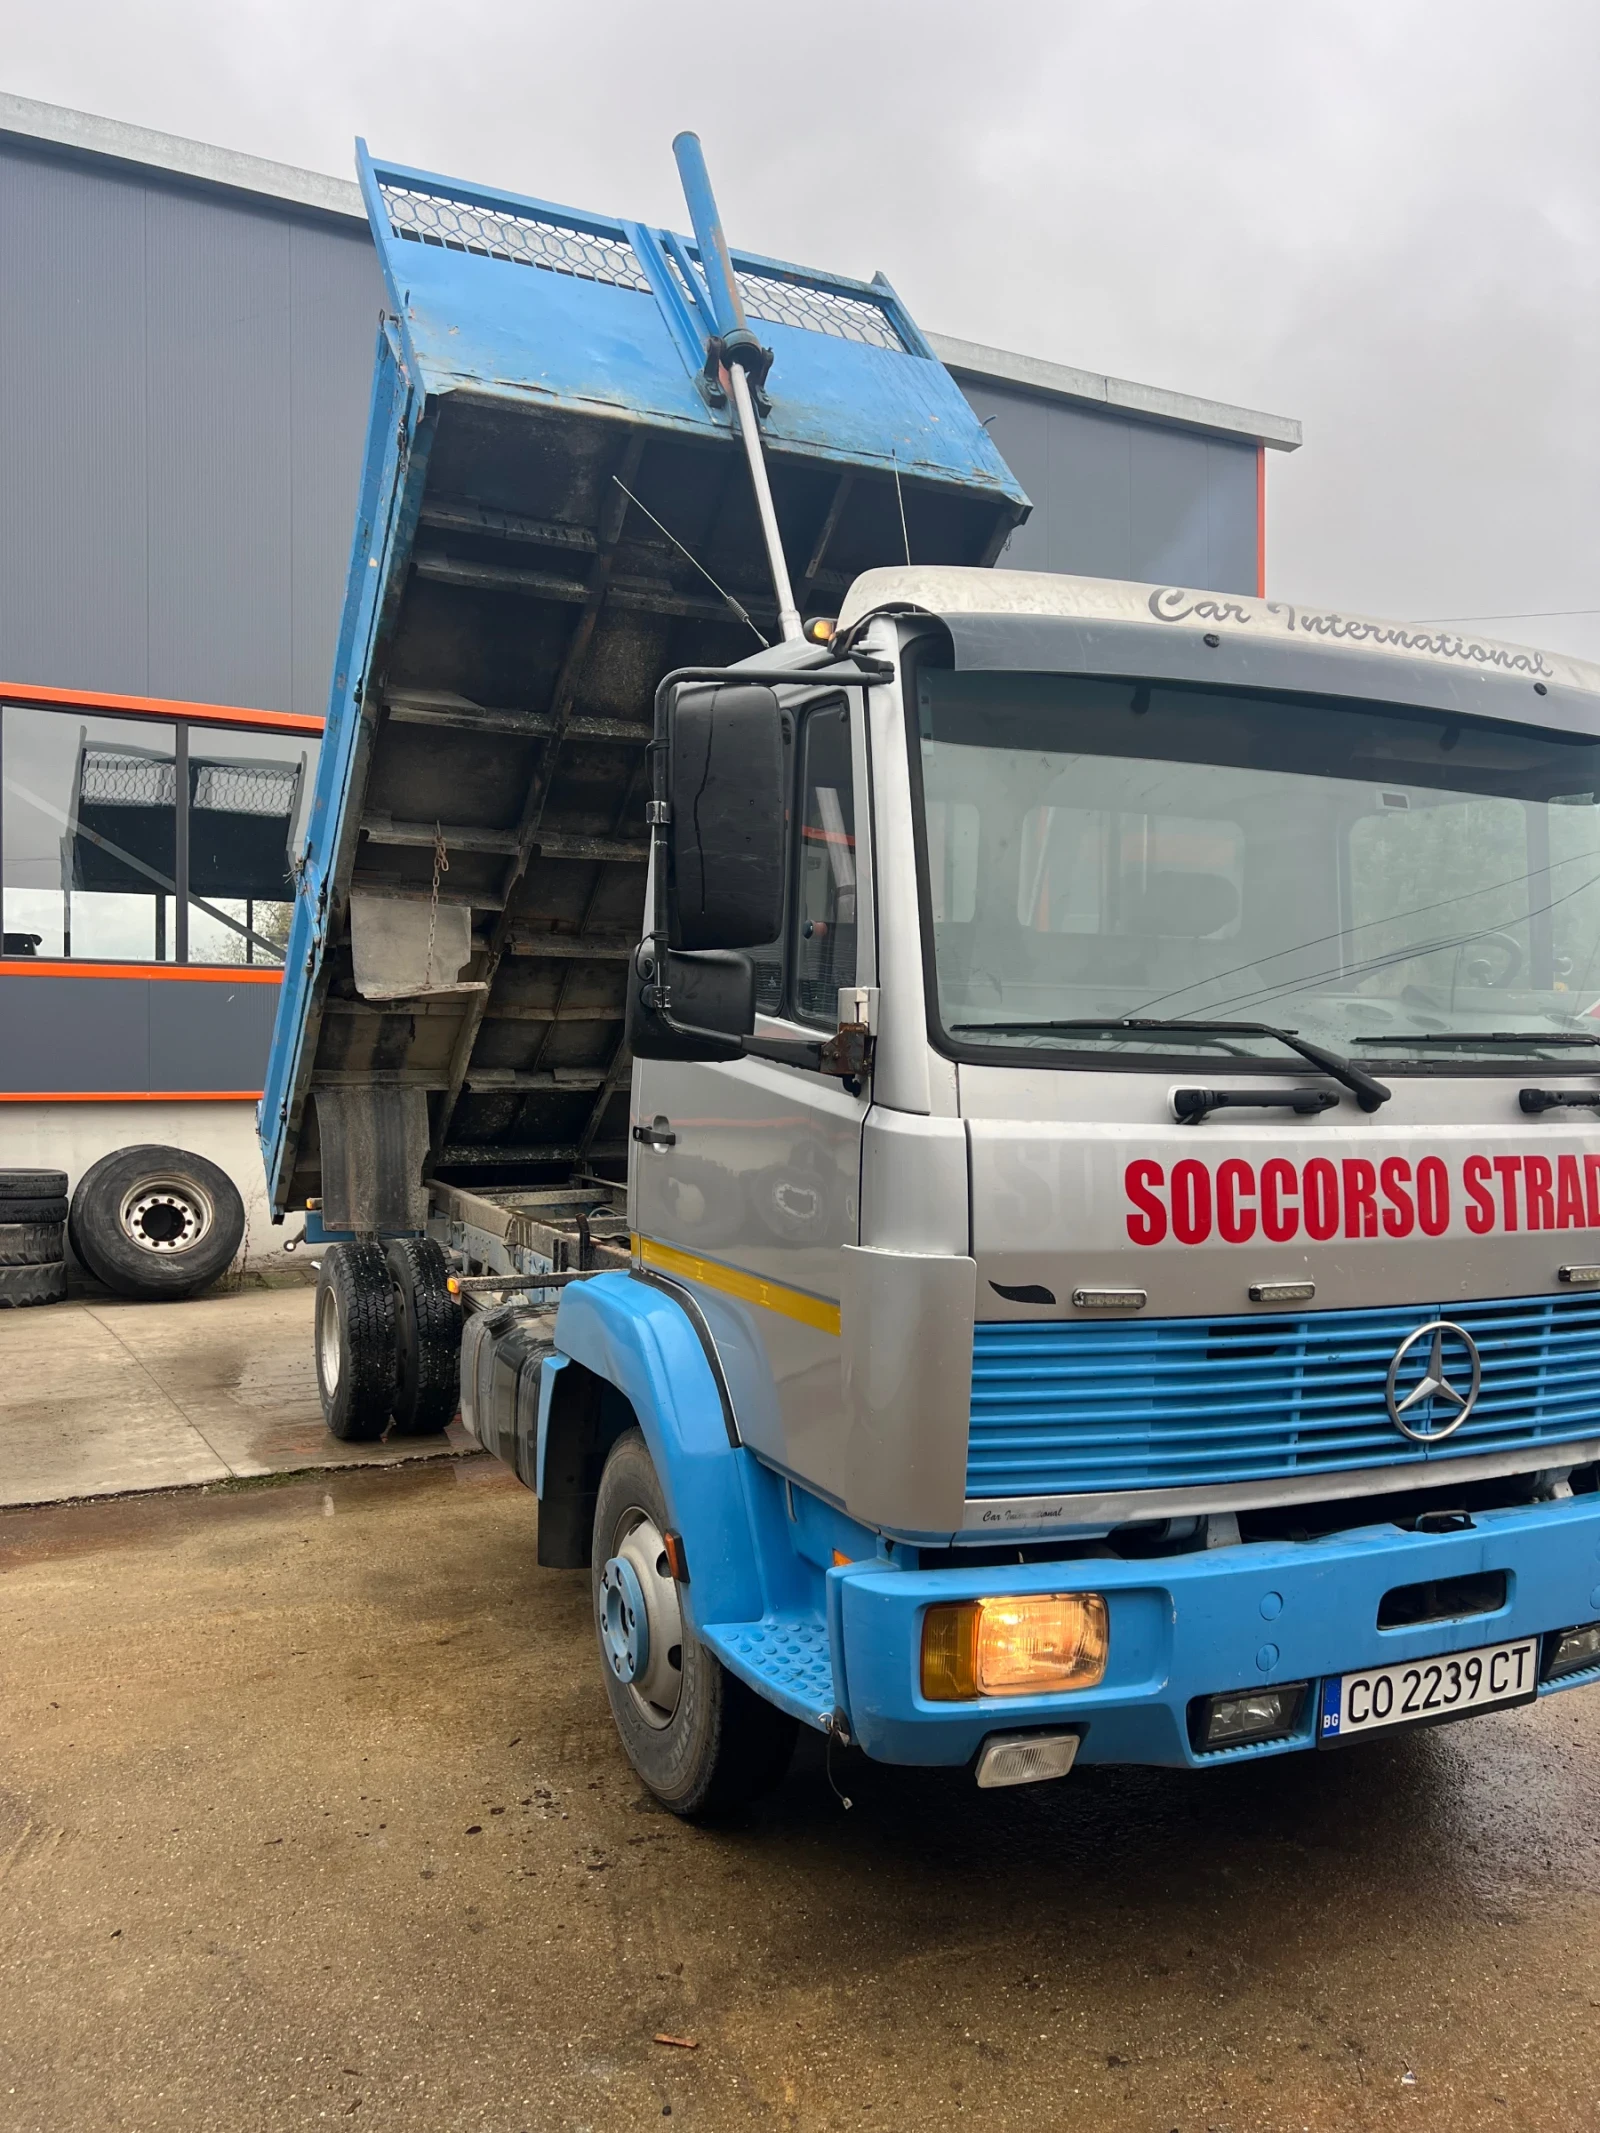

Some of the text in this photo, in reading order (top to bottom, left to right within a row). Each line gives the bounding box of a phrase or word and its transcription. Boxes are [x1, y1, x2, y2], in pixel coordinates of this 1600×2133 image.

[1148, 587, 1554, 678] Car International
[1124, 1155, 1450, 1246] SOCCORSO
[1462, 1153, 1600, 1235] STRAD
[983, 1510, 1001, 1521] Car
[1323, 1713, 1339, 1729] BG
